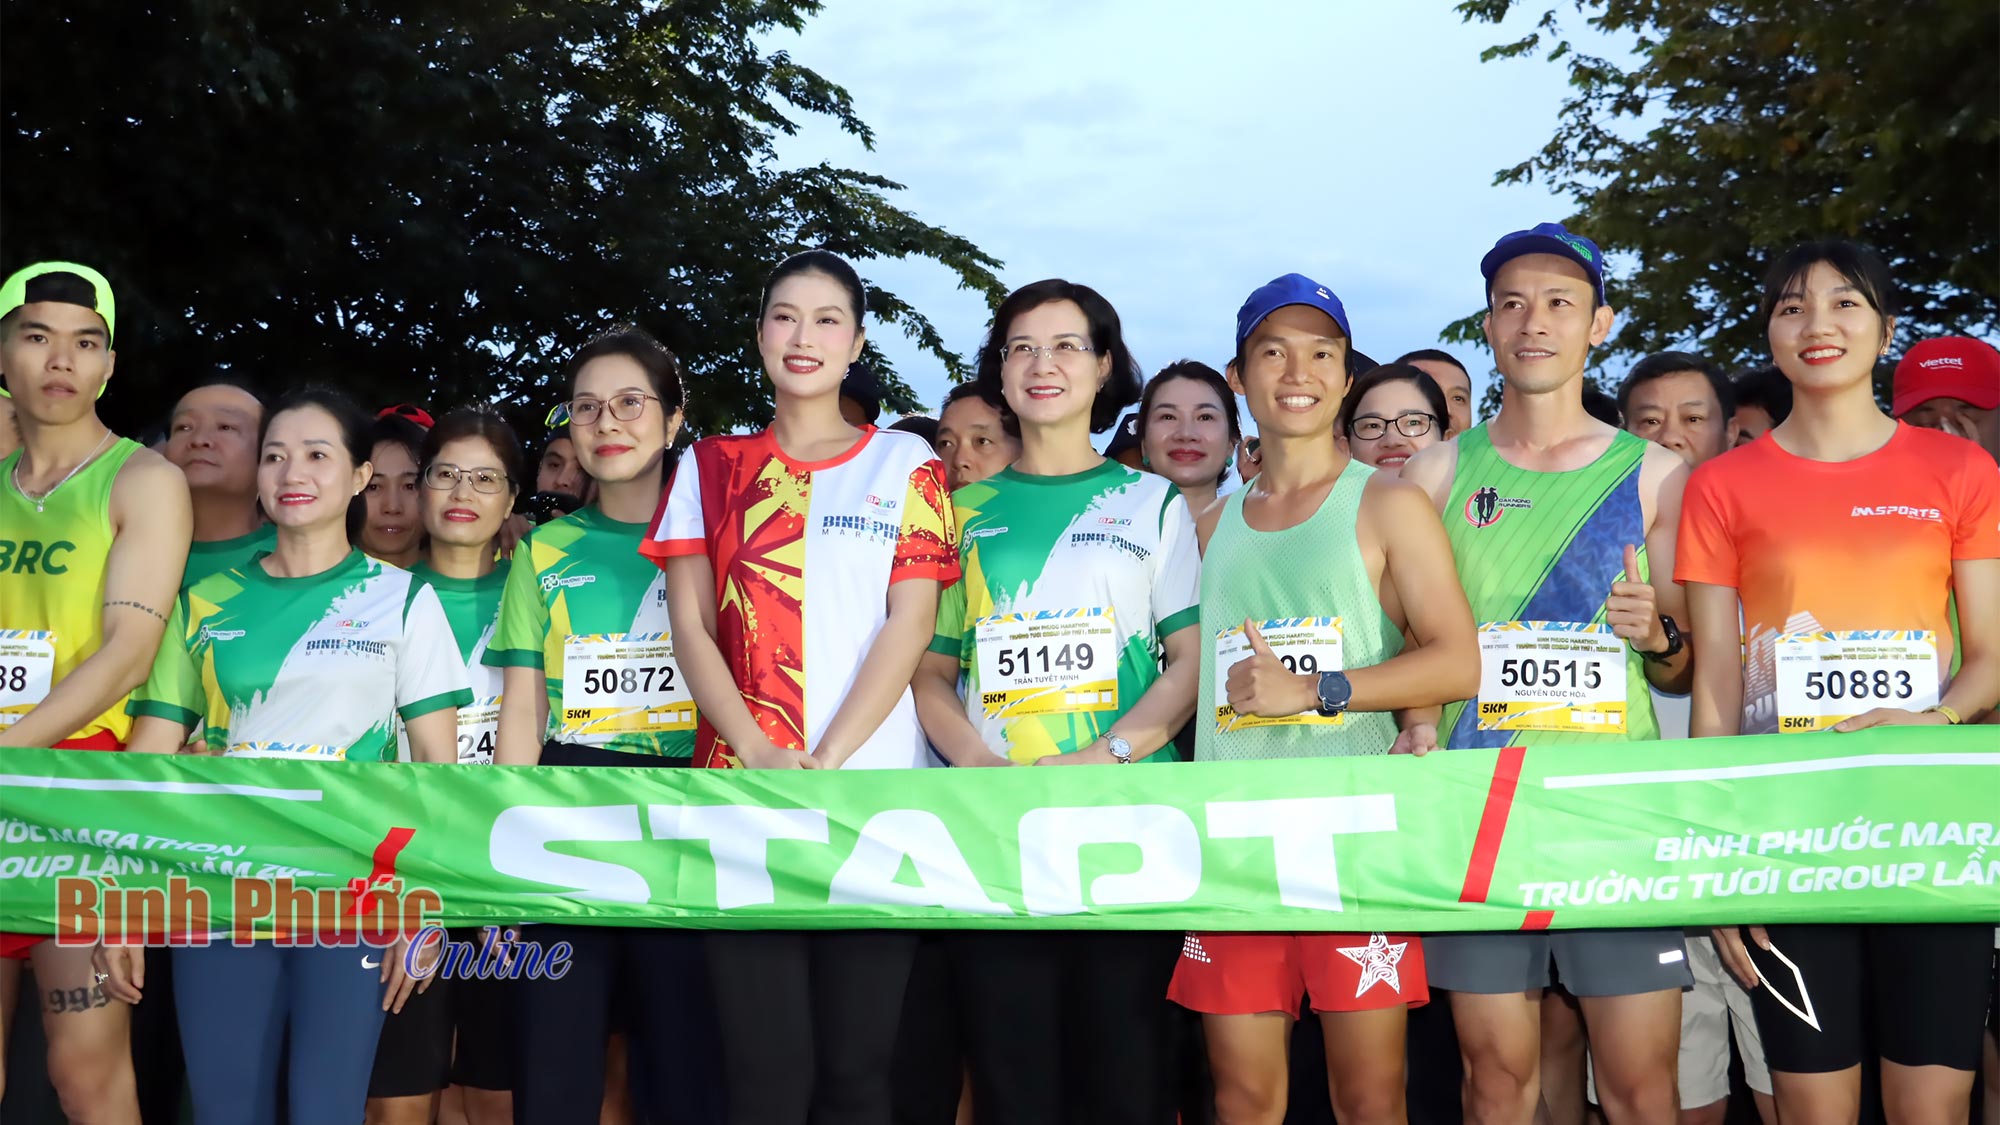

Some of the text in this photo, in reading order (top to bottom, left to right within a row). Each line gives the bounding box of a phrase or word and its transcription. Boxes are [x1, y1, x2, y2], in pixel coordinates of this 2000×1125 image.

[1919, 357, 1963, 368] viettel
[0, 540, 77, 575] BRC
[998, 643, 1094, 677] 51149
[1501, 658, 1602, 689] 50515
[584, 666, 675, 694] 50872
[1805, 669, 1913, 700] 50883
[566, 709, 591, 719] 5KM
[983, 693, 1007, 704] 5KM
[1482, 703, 1507, 713] 5KM
[1784, 717, 1815, 728] 5KM
[458, 731, 498, 759] 24
[47, 827, 247, 858] MARATHON
[1654, 827, 1750, 862] BÌNH
[1758, 815, 1894, 855] PHƯỚC
[489, 793, 1397, 917] START
[1518, 869, 1681, 908] TRƯỜNG
[1687, 866, 1781, 899] TƯƠI
[1787, 862, 1926, 893] GROUP
